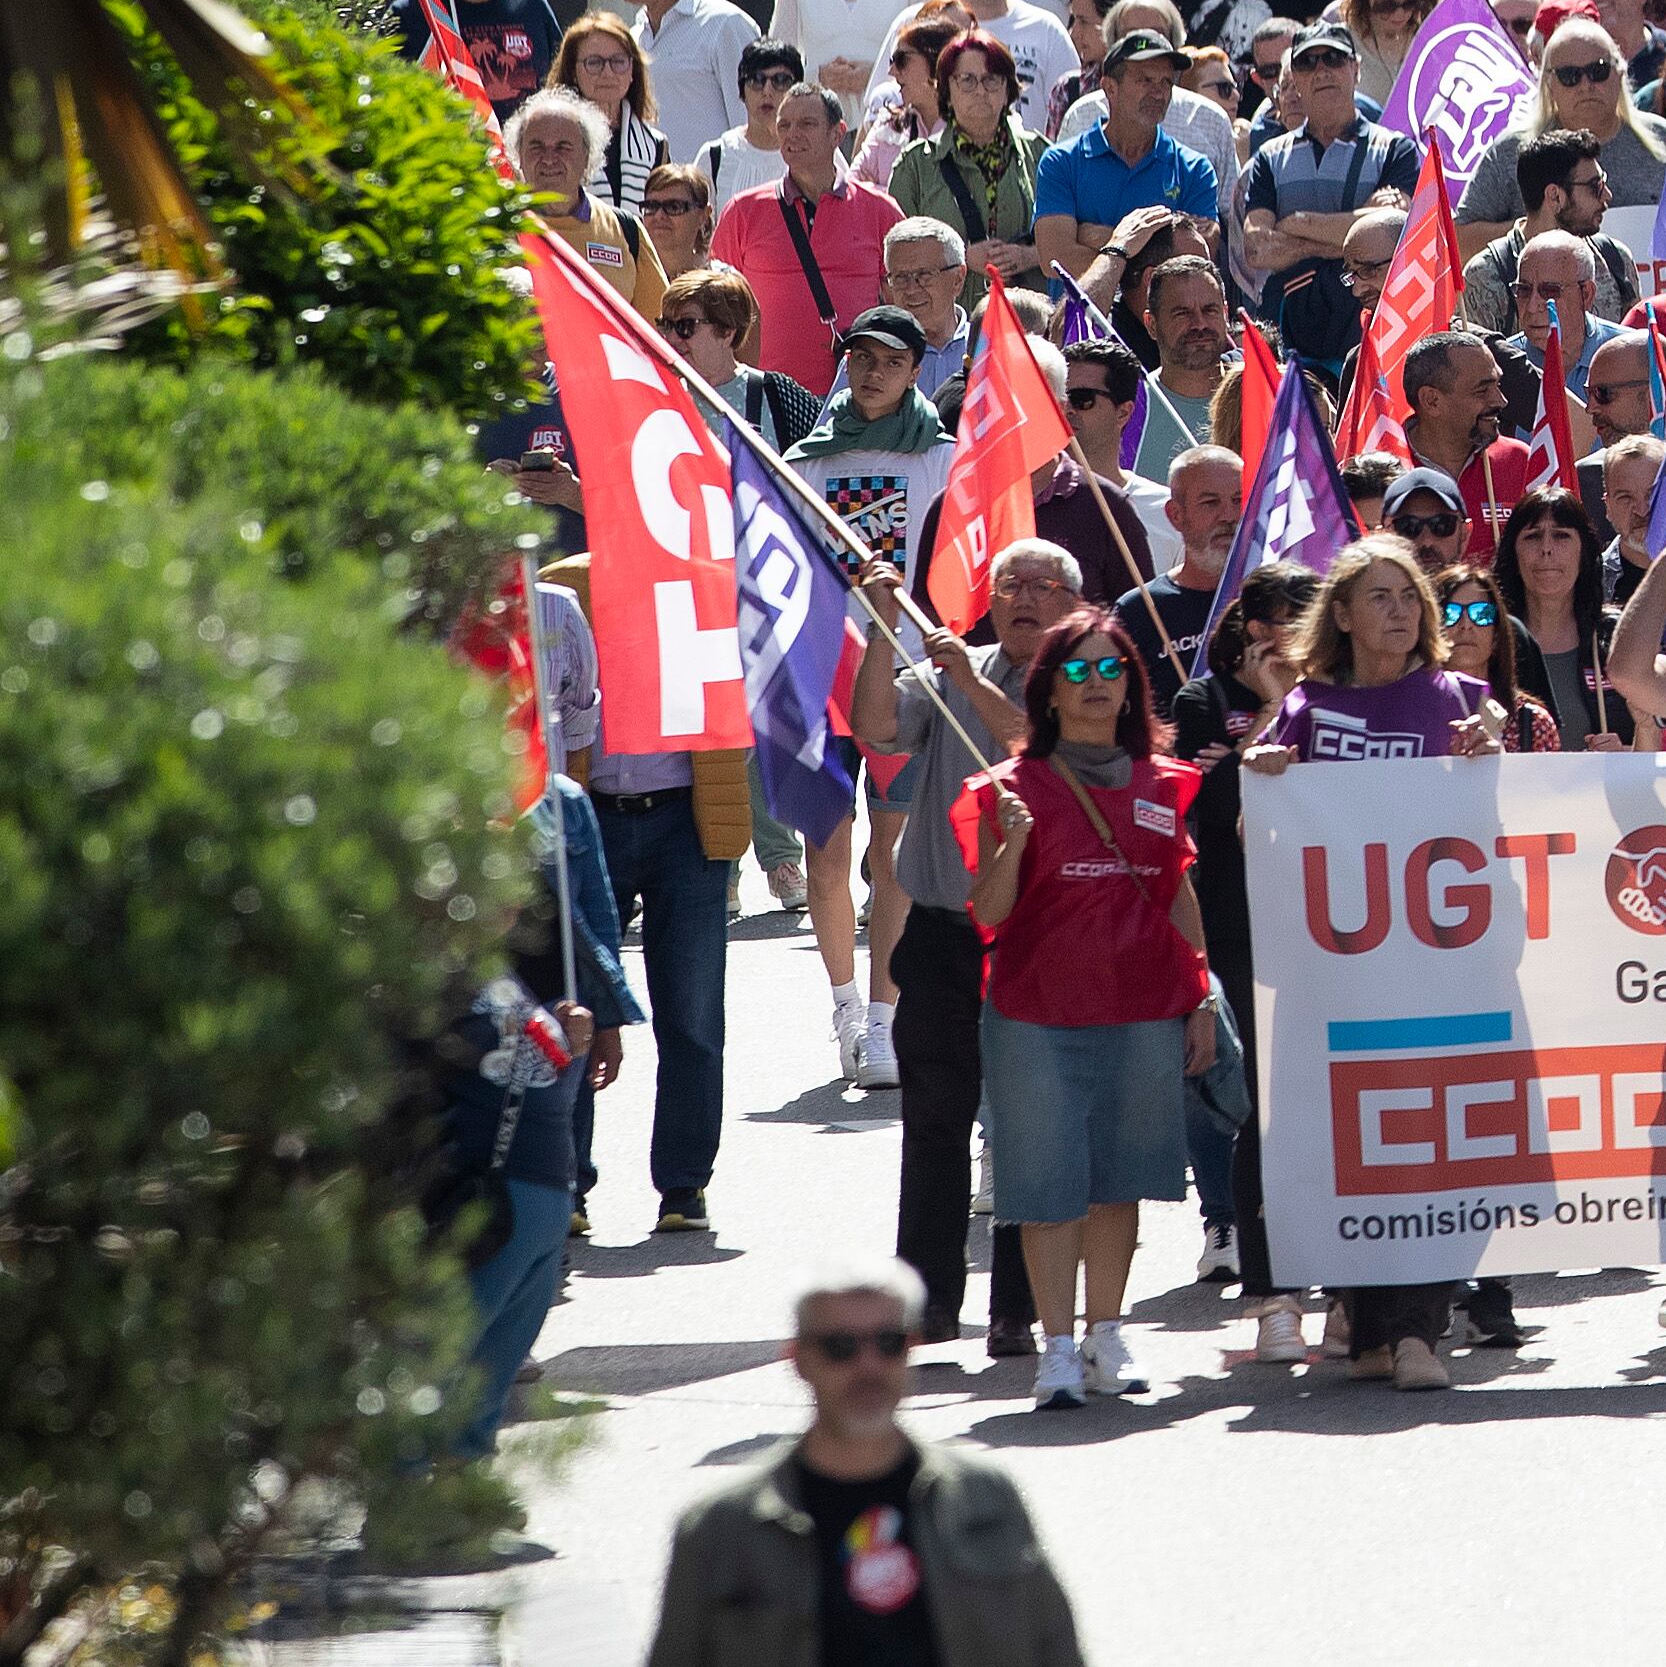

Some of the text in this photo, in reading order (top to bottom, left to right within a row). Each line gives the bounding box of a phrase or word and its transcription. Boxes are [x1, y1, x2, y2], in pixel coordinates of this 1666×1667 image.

[588, 247, 621, 264] CCOO
[531, 429, 563, 449] UGT
[1303, 831, 1577, 955] UGT
[1336, 1197, 1540, 1241] comisións
